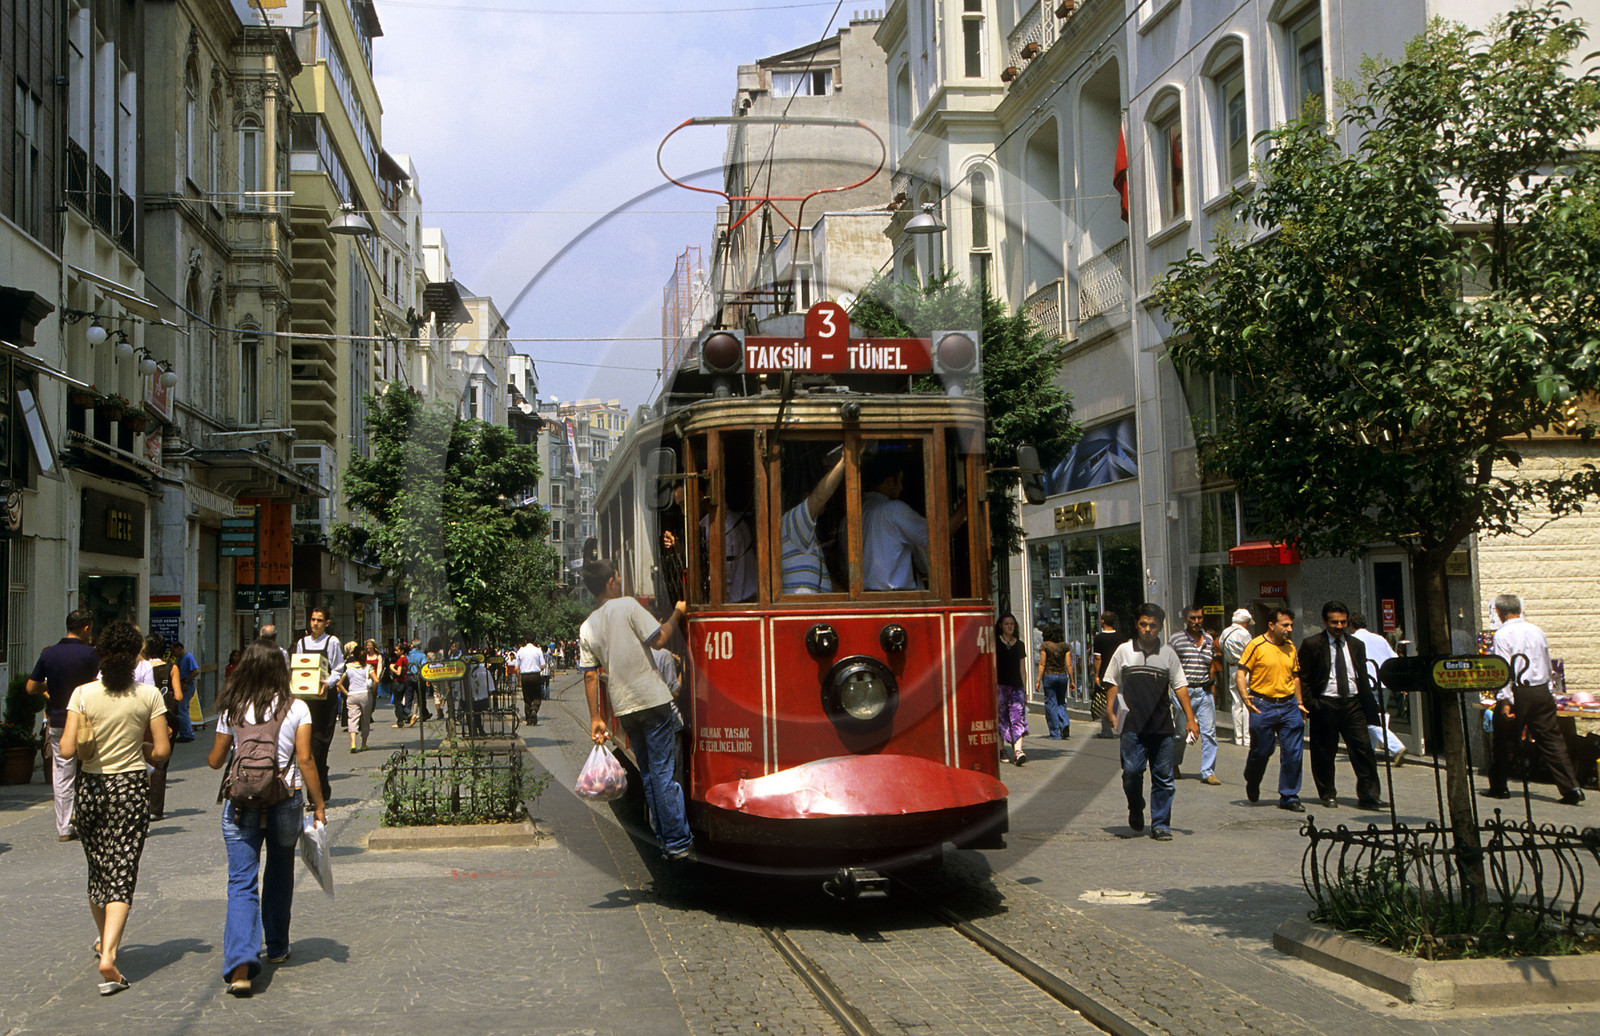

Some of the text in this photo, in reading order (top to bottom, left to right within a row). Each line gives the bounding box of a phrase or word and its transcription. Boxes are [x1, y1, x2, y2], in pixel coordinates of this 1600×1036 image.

[818, 309, 836, 338] 3
[747, 342, 811, 369] TAKSİM
[847, 343, 908, 370] TÜNEL
[1054, 501, 1095, 529] BEKO
[704, 631, 733, 660] 410
[1436, 670, 1506, 678] YURTDIŞI
[1445, 661, 1471, 669] Berlitz
[724, 727, 750, 739] YASAK
[967, 734, 979, 746] VE
